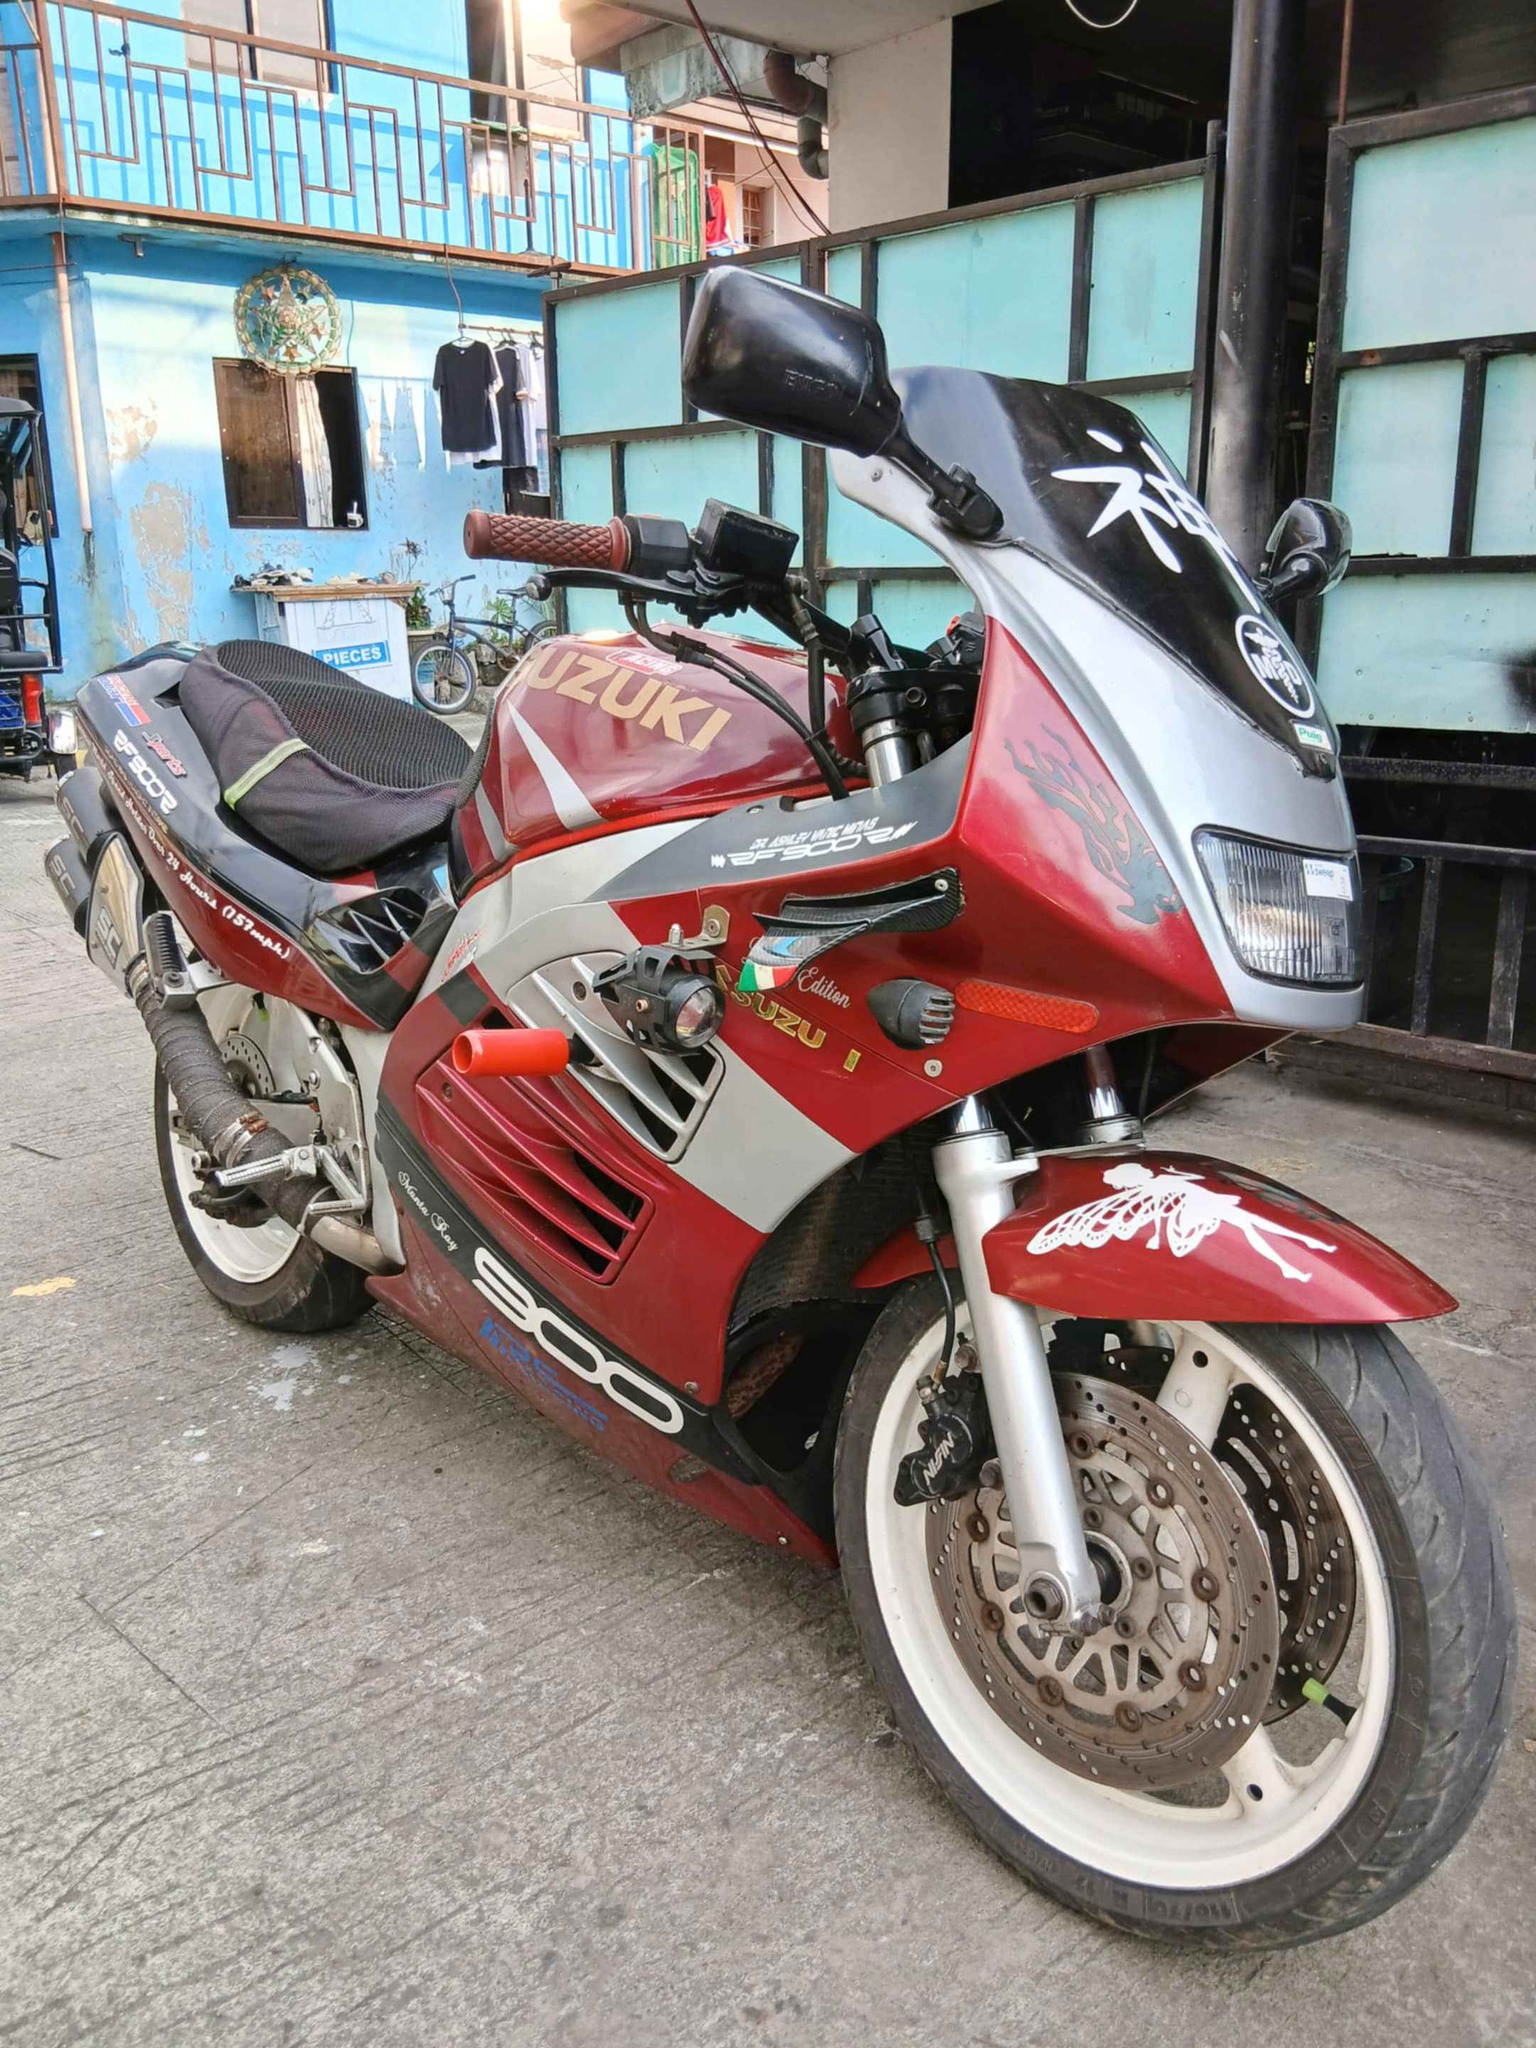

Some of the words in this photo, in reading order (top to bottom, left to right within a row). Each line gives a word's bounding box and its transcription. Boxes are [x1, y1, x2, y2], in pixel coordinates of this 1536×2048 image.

[322, 646, 382, 666] PIECES
[1299, 727, 1323, 743] Puig
[166, 851, 180, 871] 24
[179, 871, 218, 910] Hours
[798, 967, 850, 1008] Edition
[398, 1171, 430, 1216] Manta
[431, 1212, 459, 1252] Ray
[472, 1246, 684, 1434] 900
